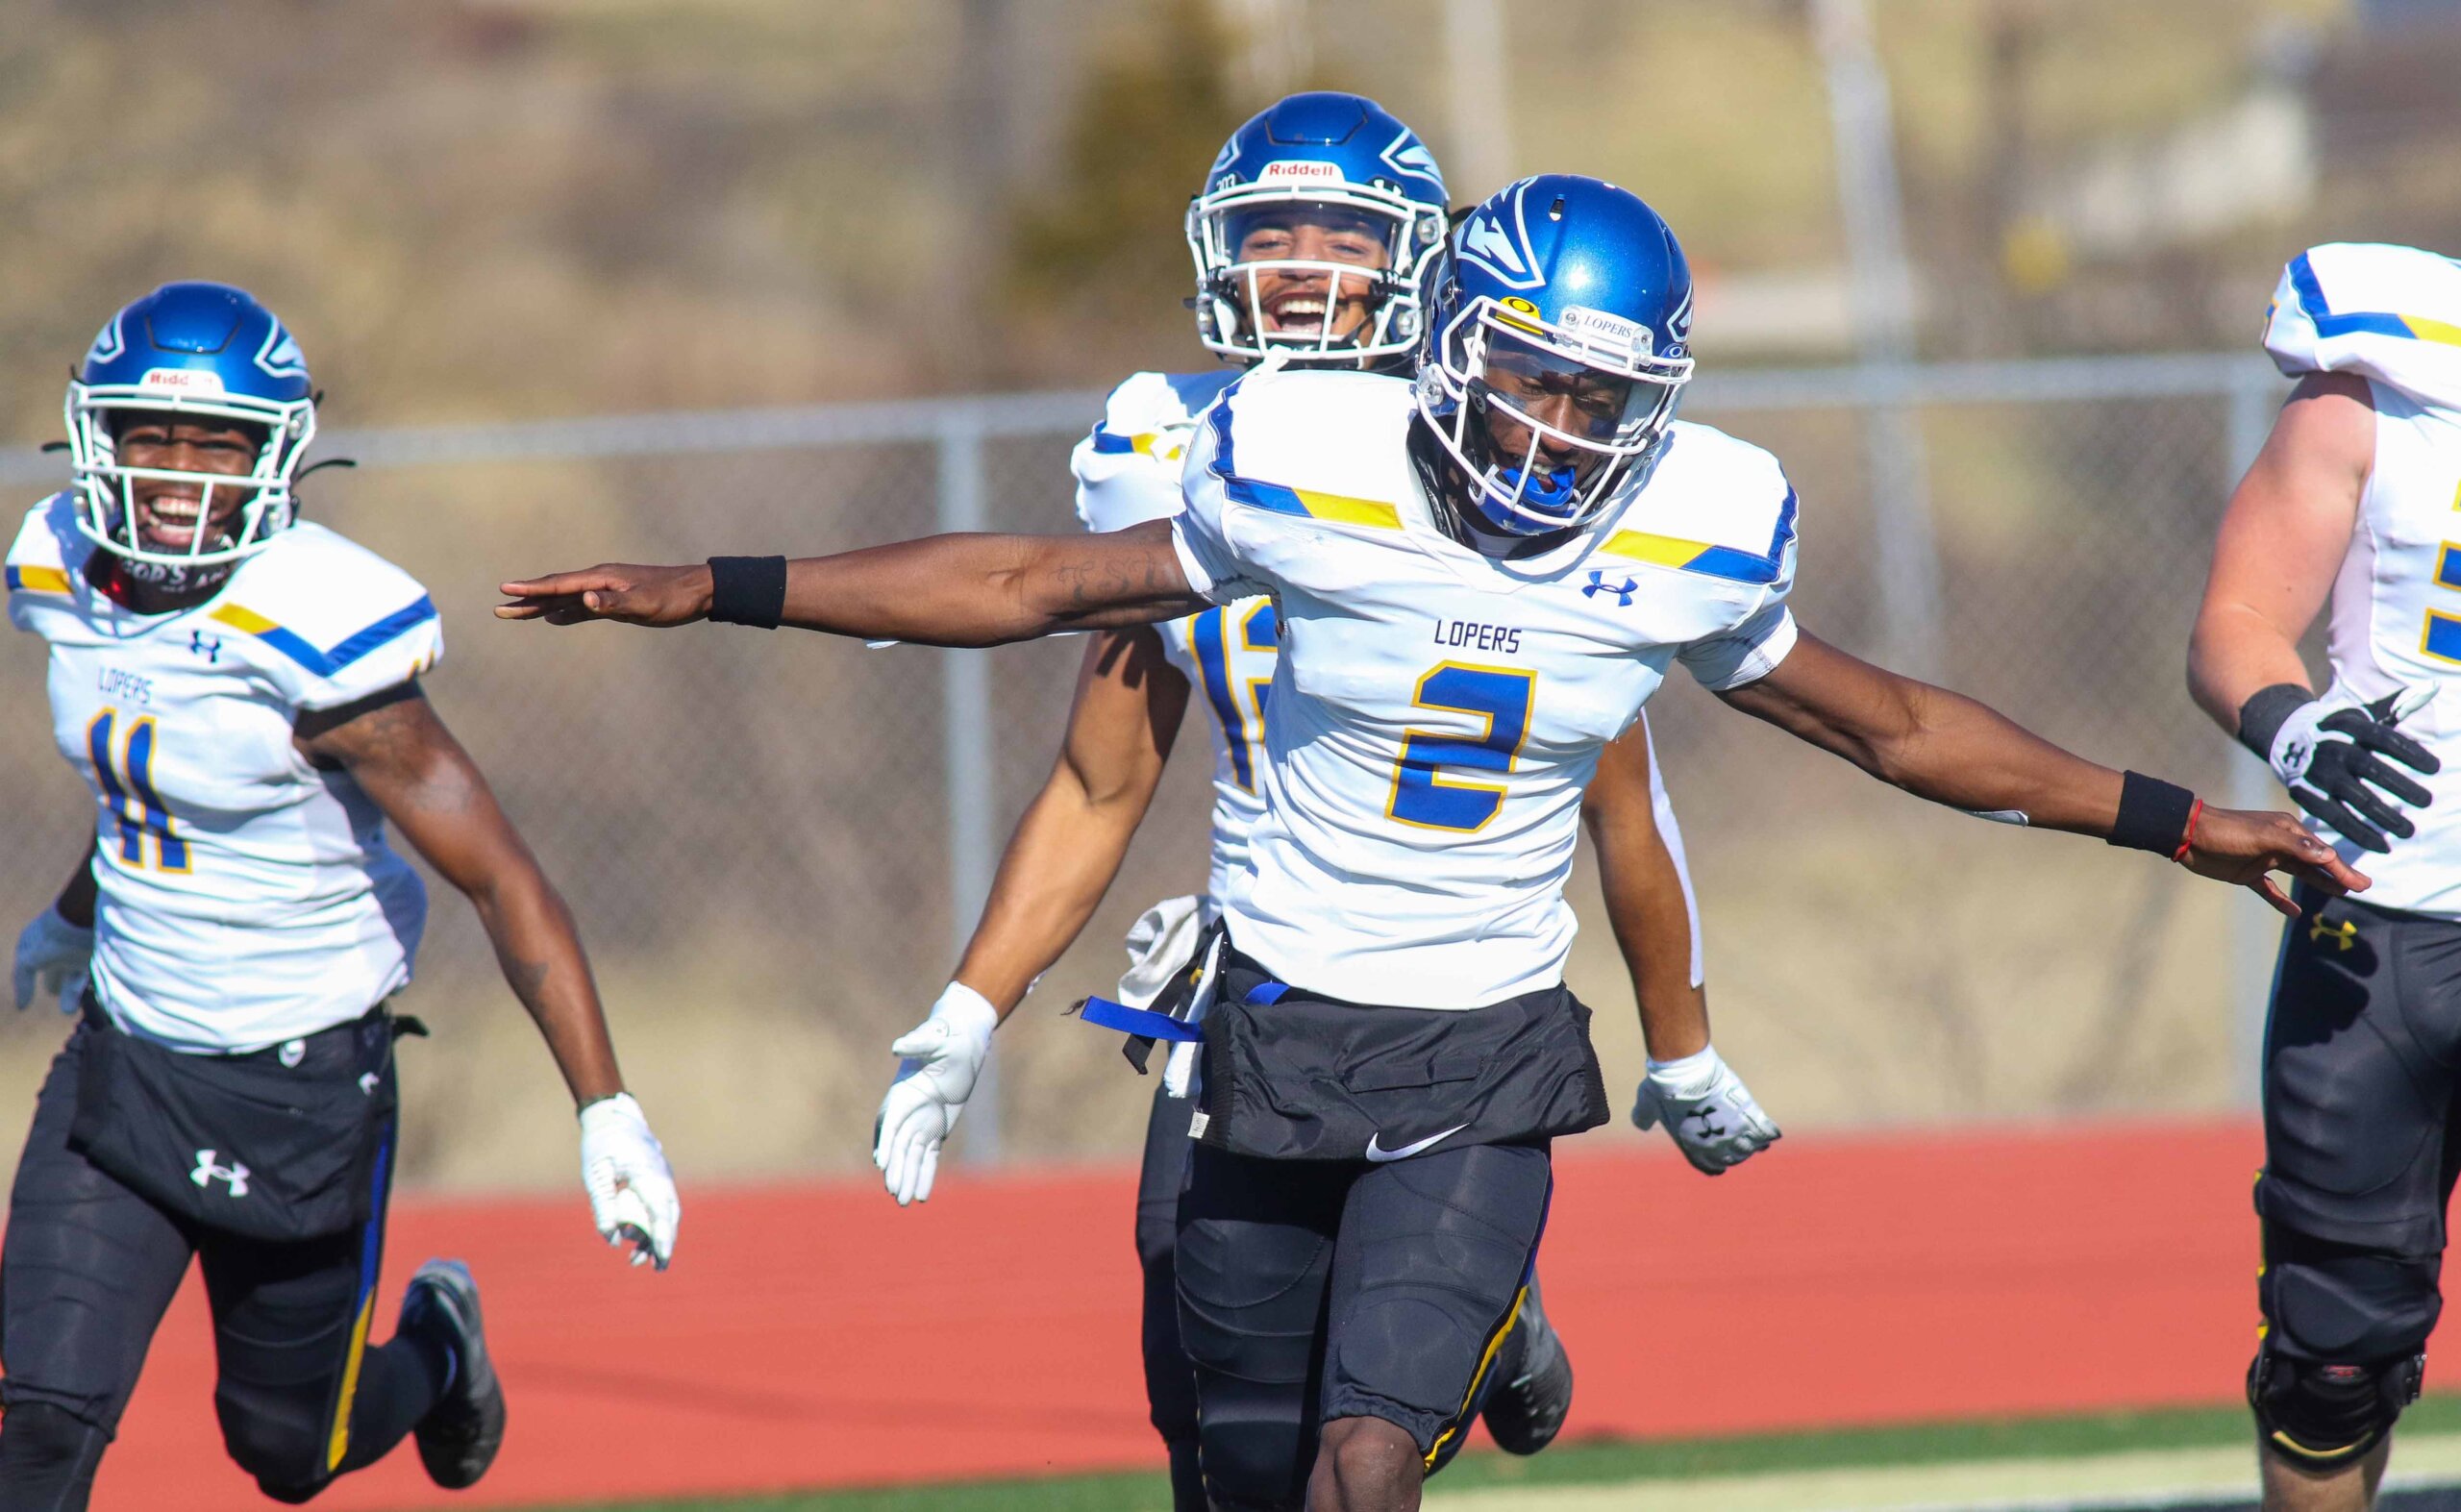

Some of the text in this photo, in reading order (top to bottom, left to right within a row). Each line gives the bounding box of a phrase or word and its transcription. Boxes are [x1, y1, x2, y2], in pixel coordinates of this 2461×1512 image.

[1269, 163, 1333, 177] Riddell
[1583, 313, 1632, 338] LOPERS
[1434, 619, 1522, 654] LOPERS
[98, 665, 154, 705] LOPERS
[1384, 658, 1538, 833] 2
[86, 706, 193, 876] 11
